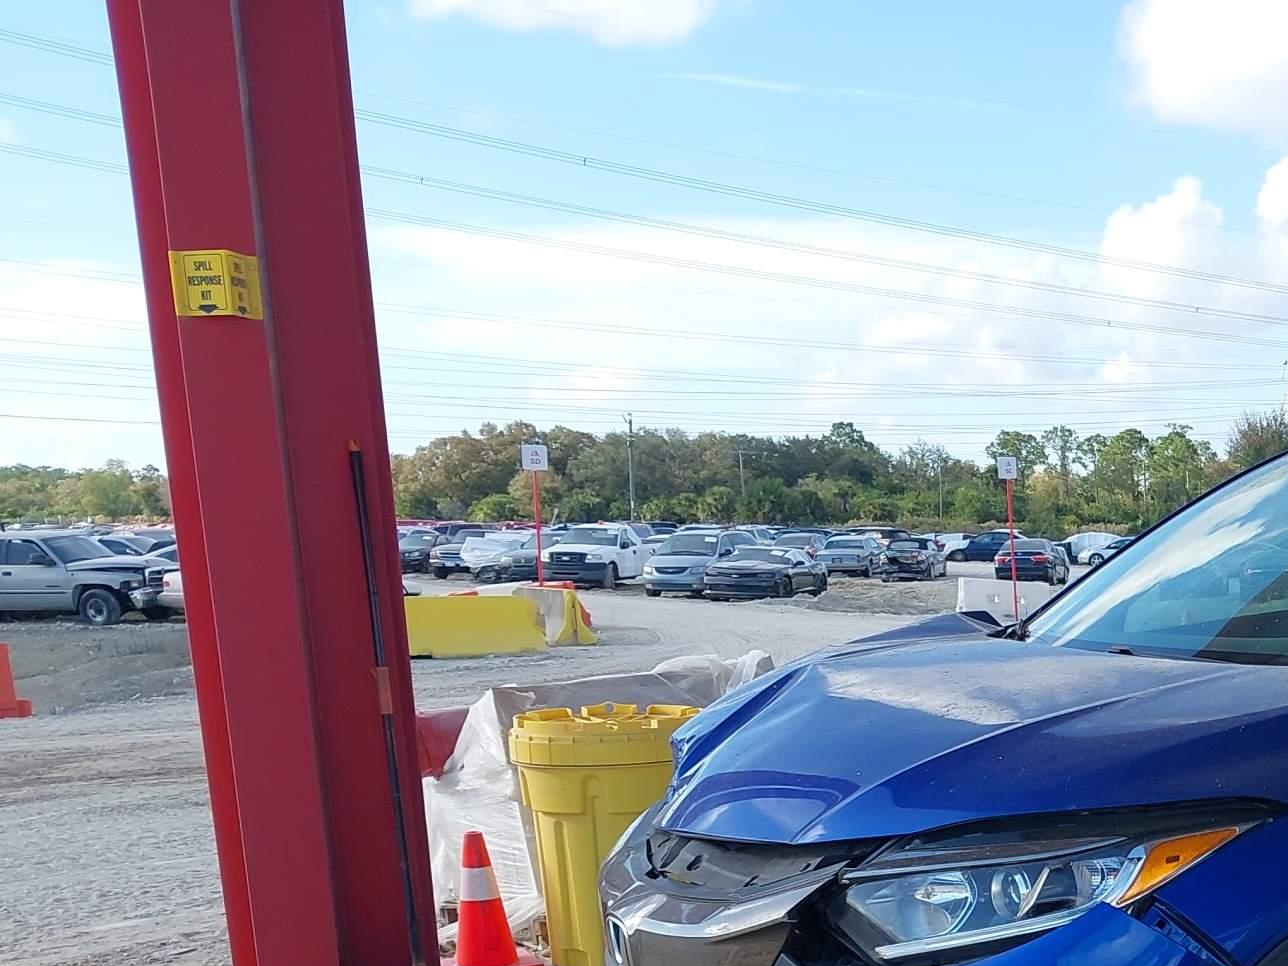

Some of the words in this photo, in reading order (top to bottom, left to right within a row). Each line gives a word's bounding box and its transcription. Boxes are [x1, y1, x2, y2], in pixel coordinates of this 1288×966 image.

[193, 261, 213, 271] SPILL
[187, 275, 222, 286] RESPONSE
[201, 290, 212, 300] KIT
